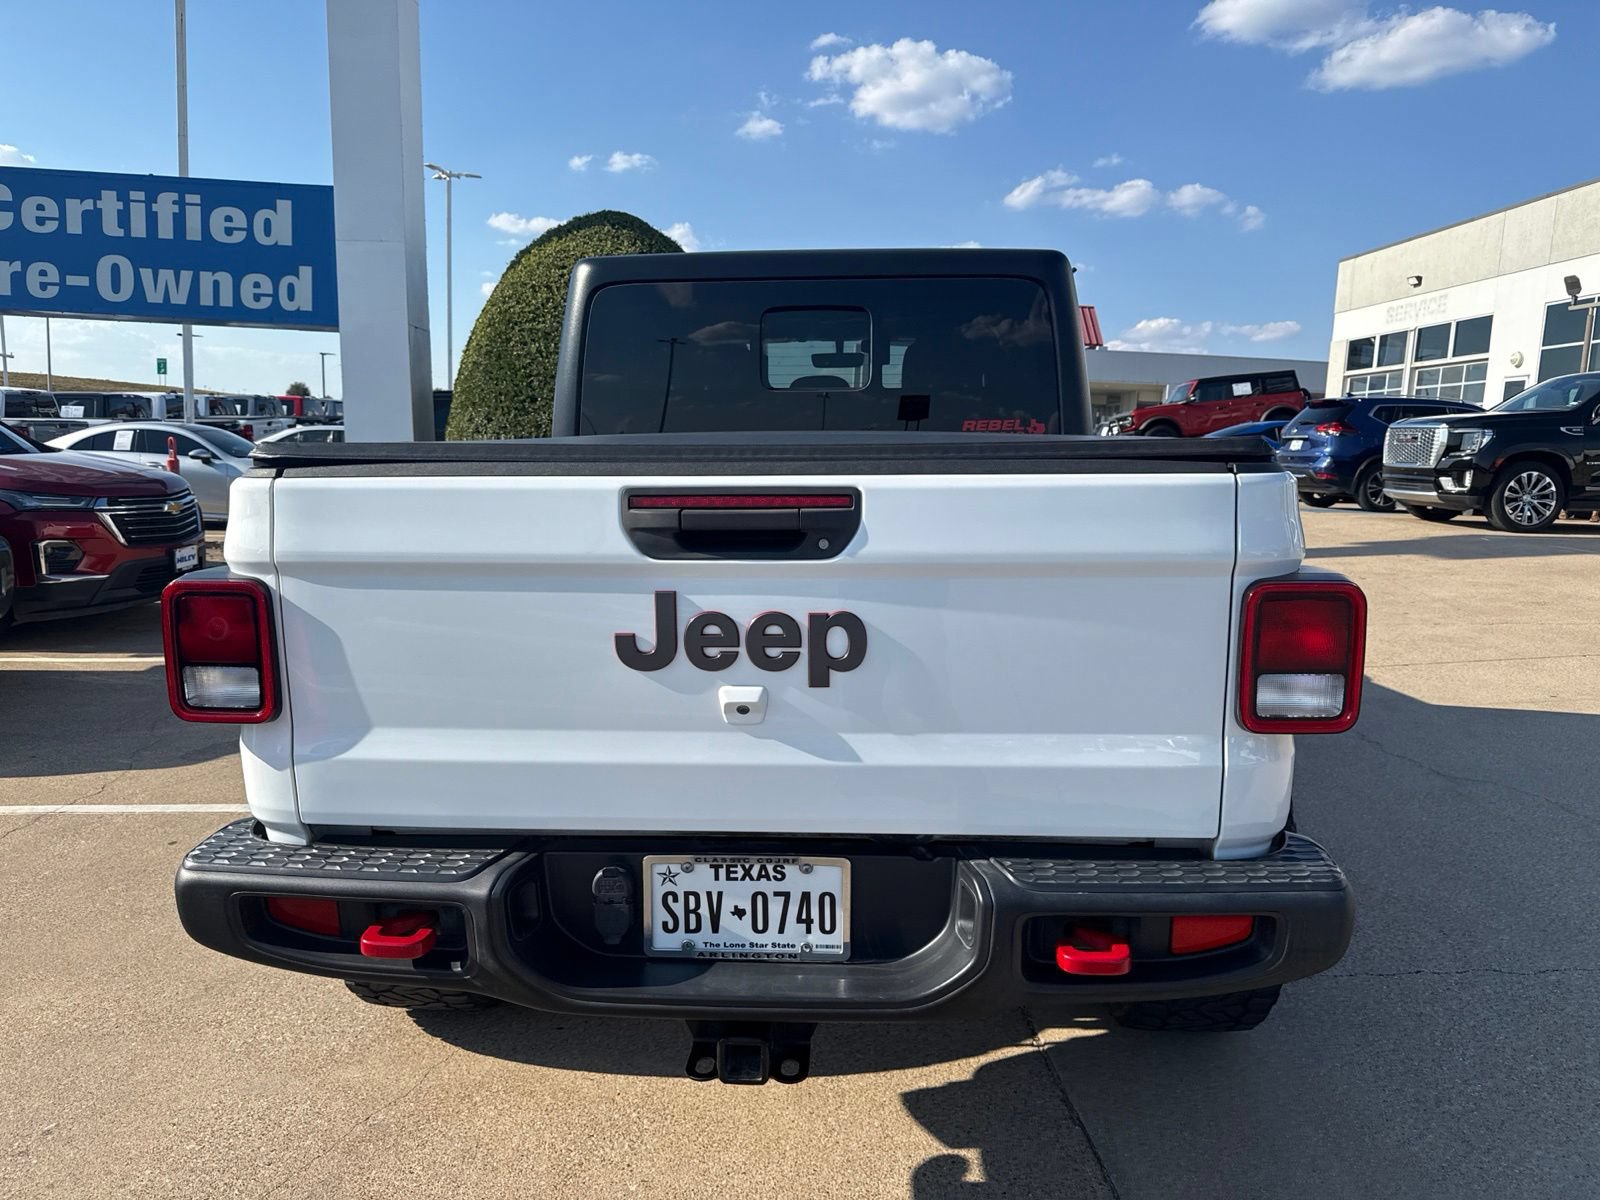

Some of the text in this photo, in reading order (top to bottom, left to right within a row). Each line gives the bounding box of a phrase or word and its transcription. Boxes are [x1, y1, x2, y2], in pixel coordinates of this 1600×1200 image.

[1385, 294, 1448, 325] SERVICE
[962, 419, 1025, 432] REBEL
[614, 590, 868, 688] Jeep
[709, 864, 786, 882] TEXAS
[661, 890, 837, 935] SBV 0740
[697, 951, 799, 959] ARLINGTON
